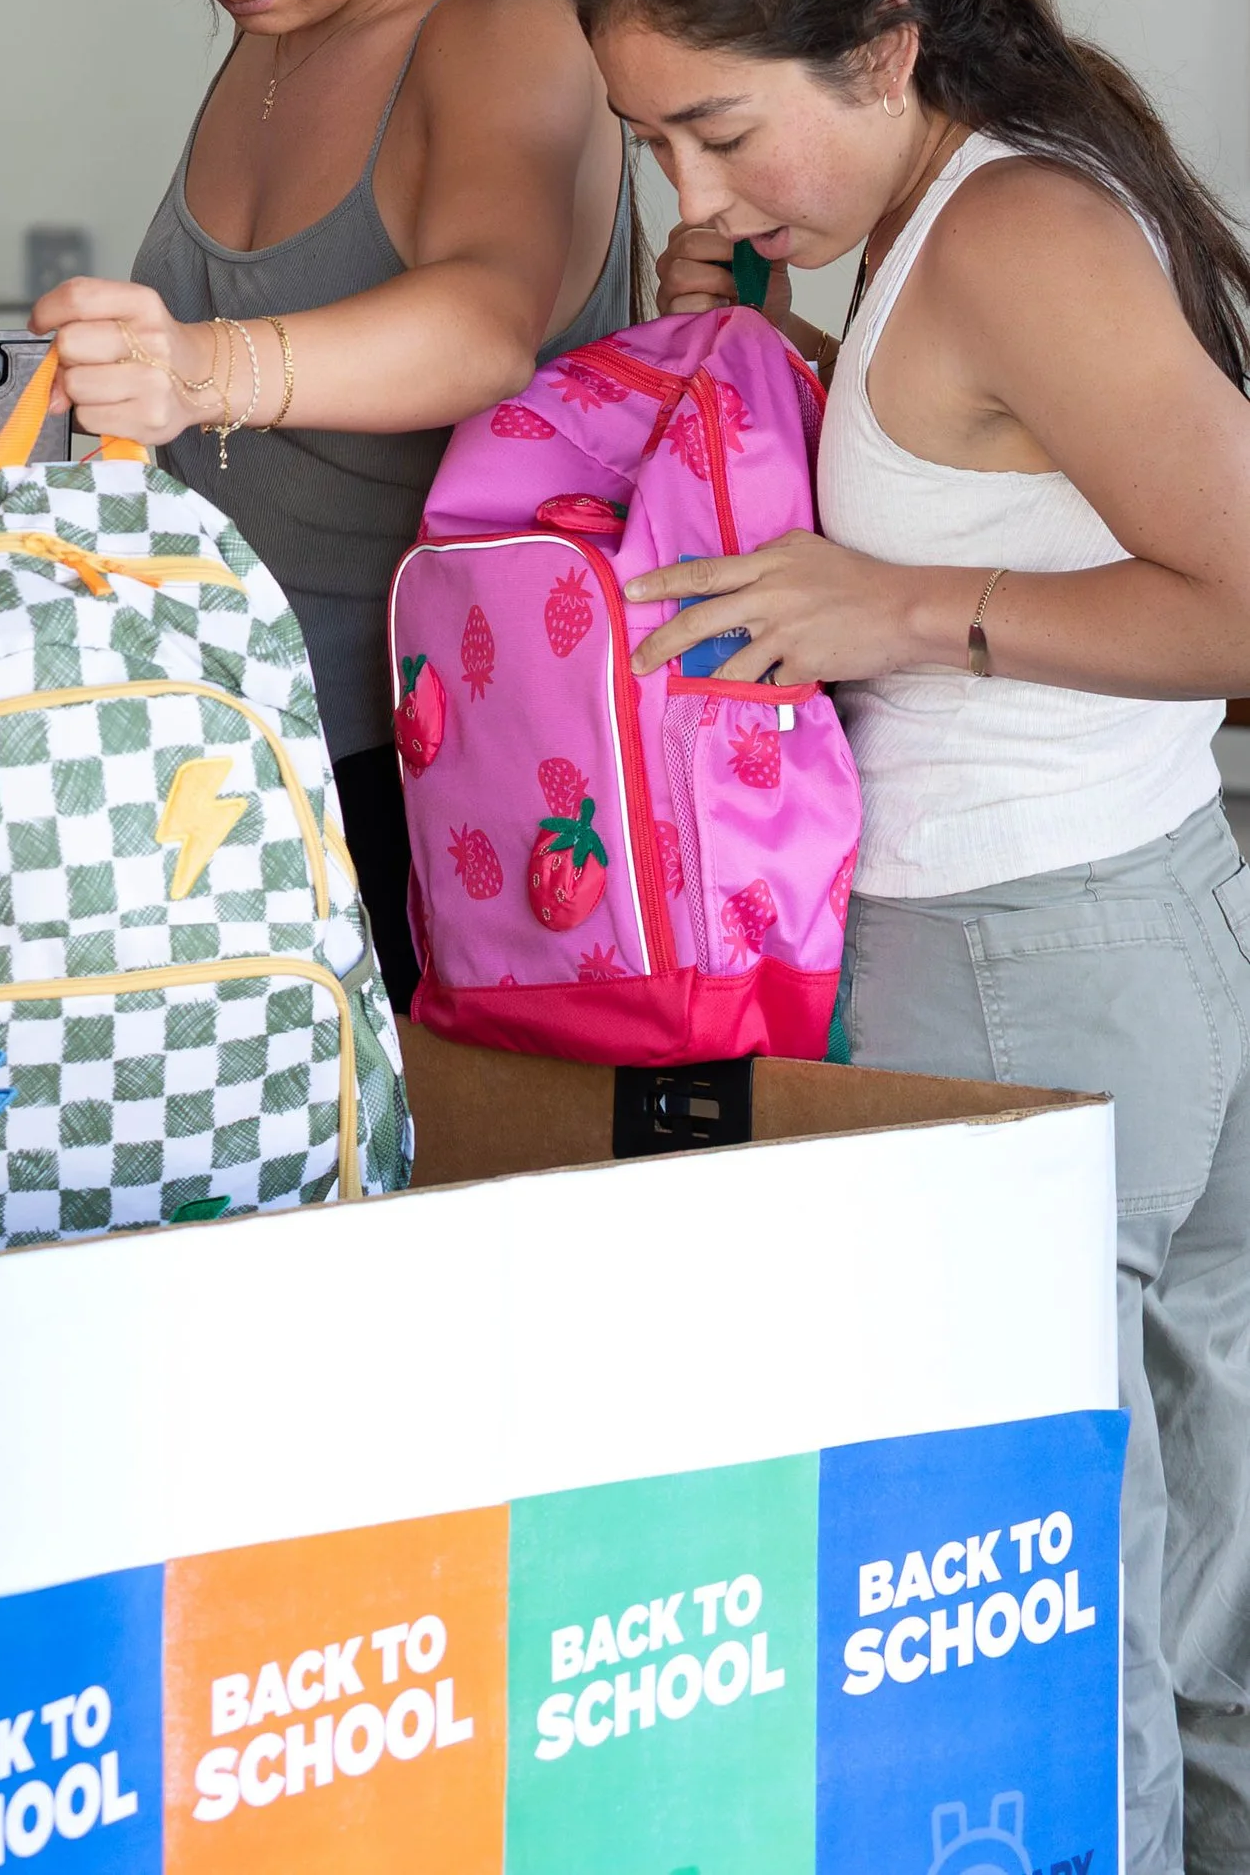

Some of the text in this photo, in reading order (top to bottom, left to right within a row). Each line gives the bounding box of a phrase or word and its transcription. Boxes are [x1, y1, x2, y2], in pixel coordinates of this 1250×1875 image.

[858, 1510, 1073, 1618] BACK TO
[210, 1614, 447, 1736] BACK TO
[550, 1573, 763, 1683] BACK TO
[841, 1569, 1096, 1696] SCHOOL
[40, 1685, 111, 1760] TO
[191, 1678, 474, 1823] SCHOOL
[534, 1632, 786, 1761] SCHOOL
